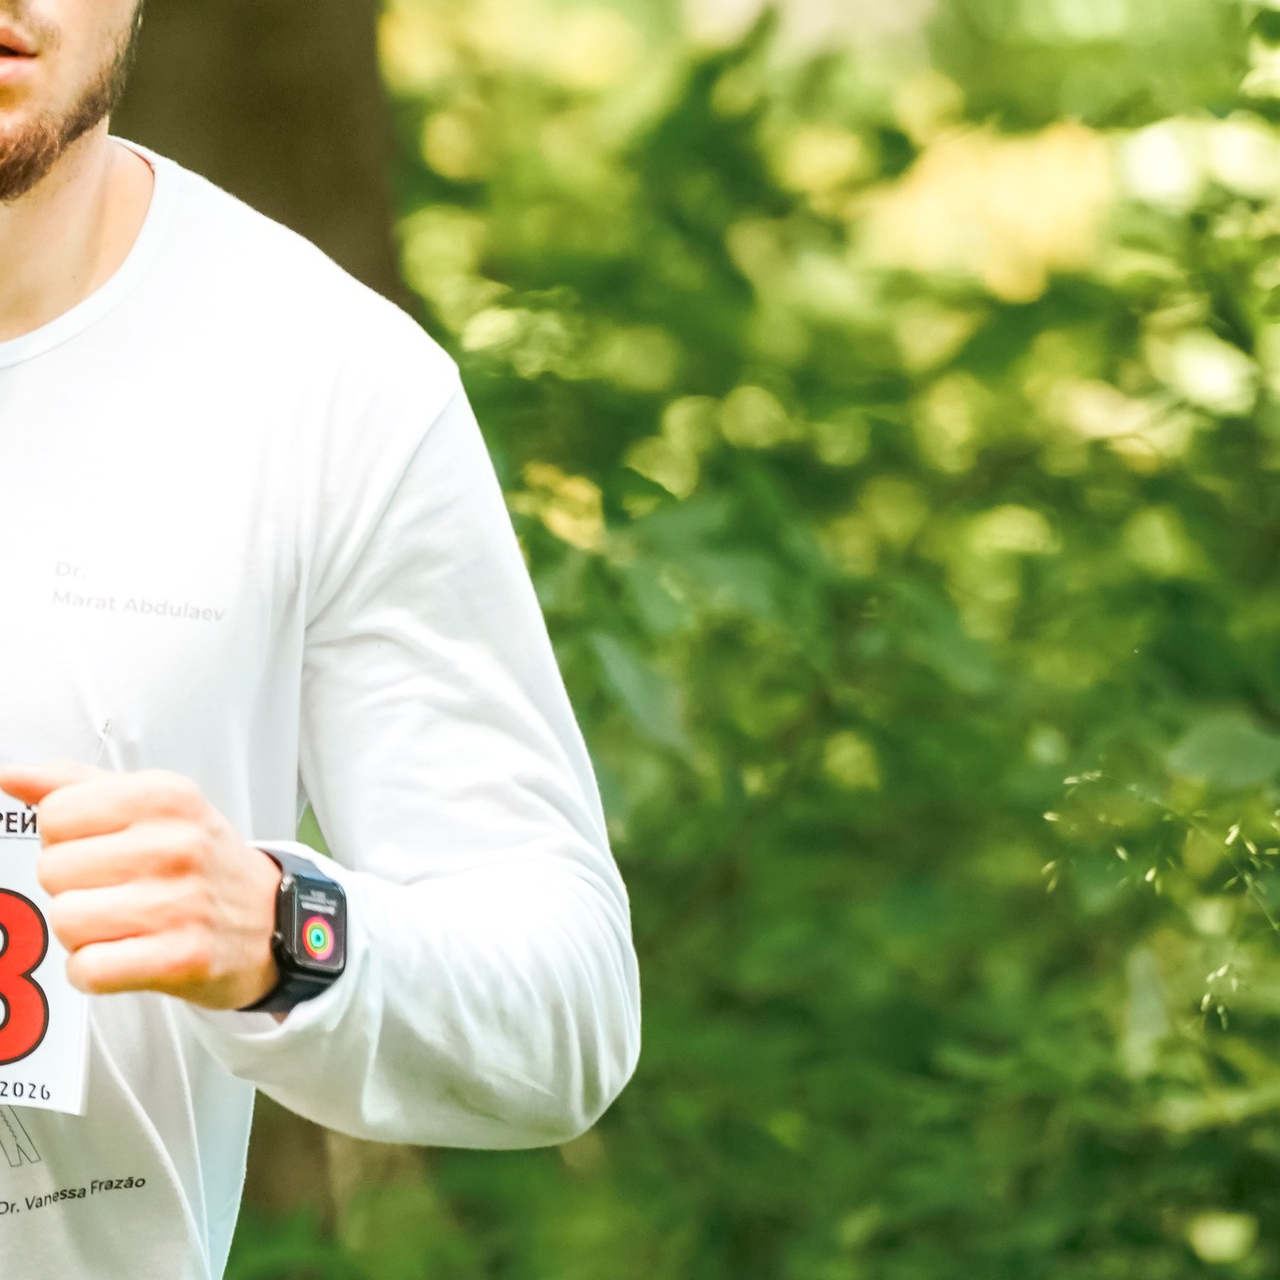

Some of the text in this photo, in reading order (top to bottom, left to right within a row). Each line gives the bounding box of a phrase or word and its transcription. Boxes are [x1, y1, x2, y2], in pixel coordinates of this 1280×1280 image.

[55, 561, 87, 580] Dr.
[52, 589, 226, 622] Marat Abdulaev
[0, 1080, 51, 1100] 2026
[25, 1185, 86, 1211] Vanessa
